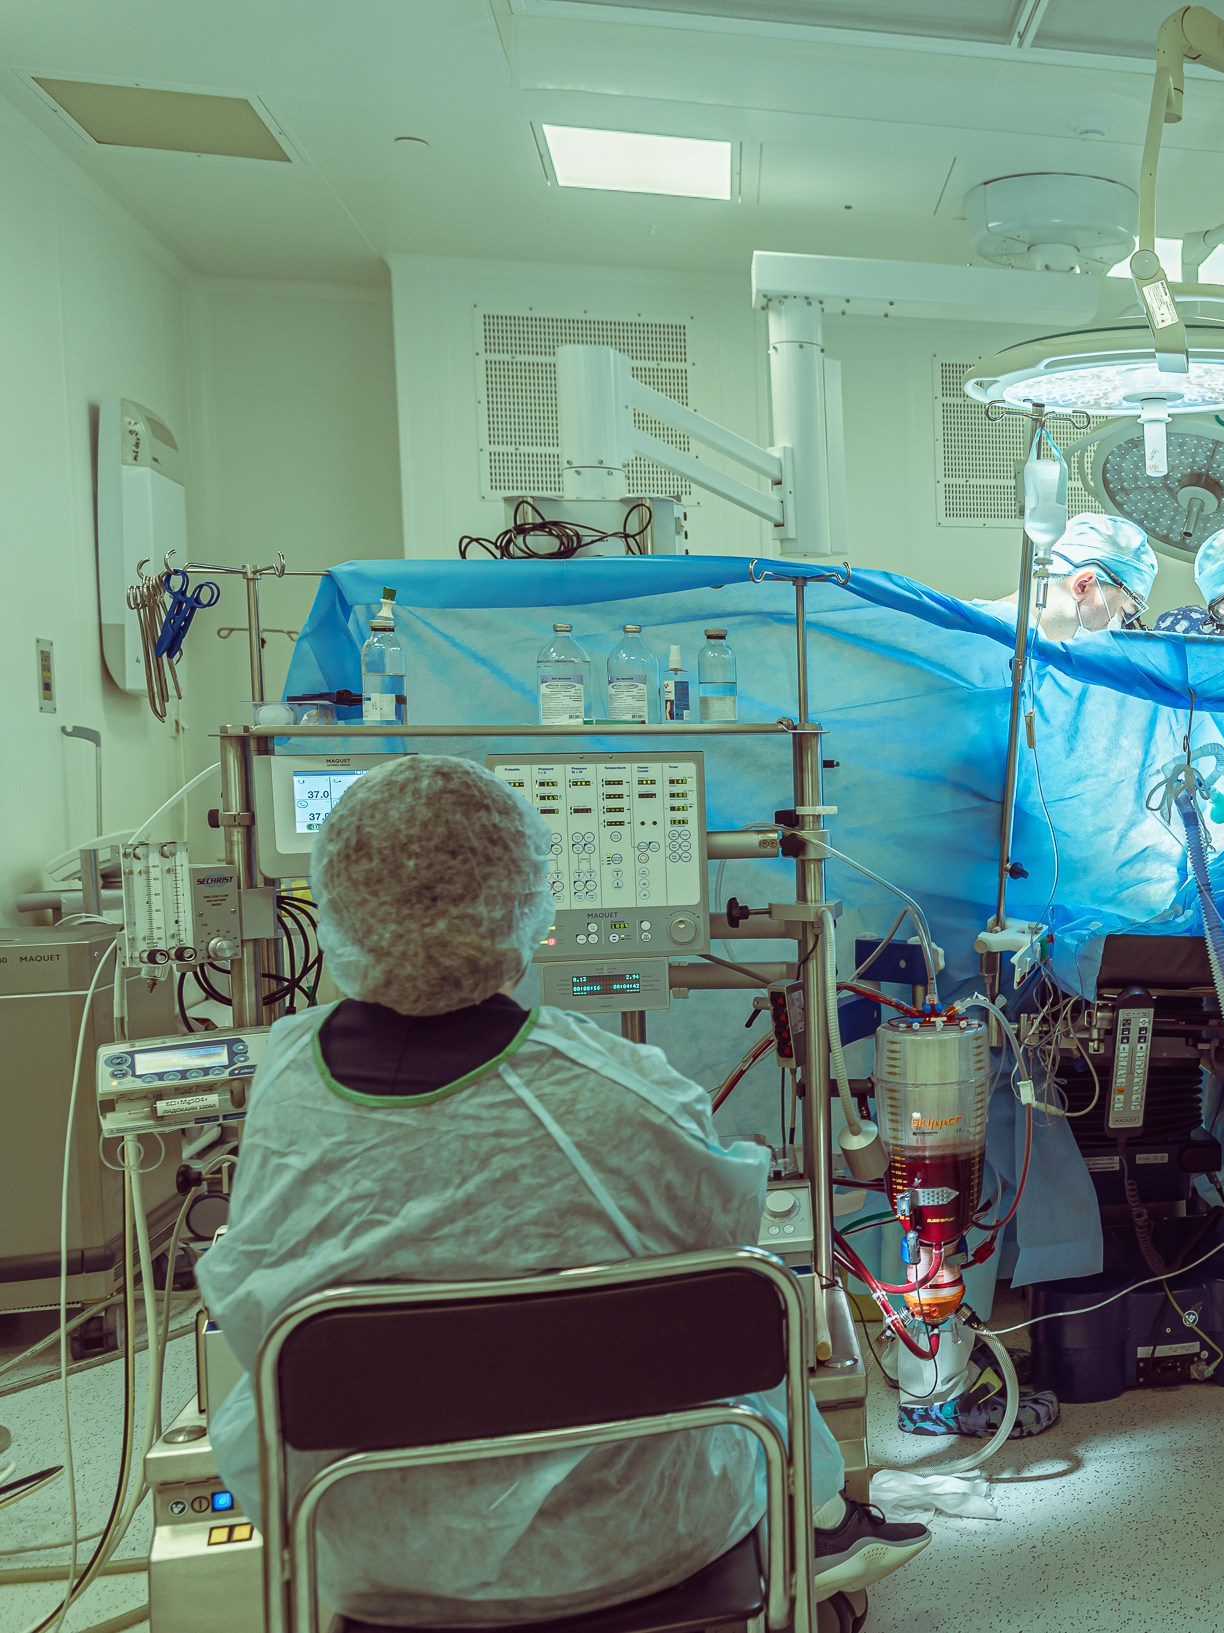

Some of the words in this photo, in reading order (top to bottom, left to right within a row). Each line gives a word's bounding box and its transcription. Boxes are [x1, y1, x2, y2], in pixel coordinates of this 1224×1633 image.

[307, 790, 330, 799] 37.0
[196, 876, 234, 886] SECHRIST
[587, 911, 619, 919] MAQUET
[19, 953, 62, 963] MAQUET
[911, 1115, 962, 1130] Skipper
